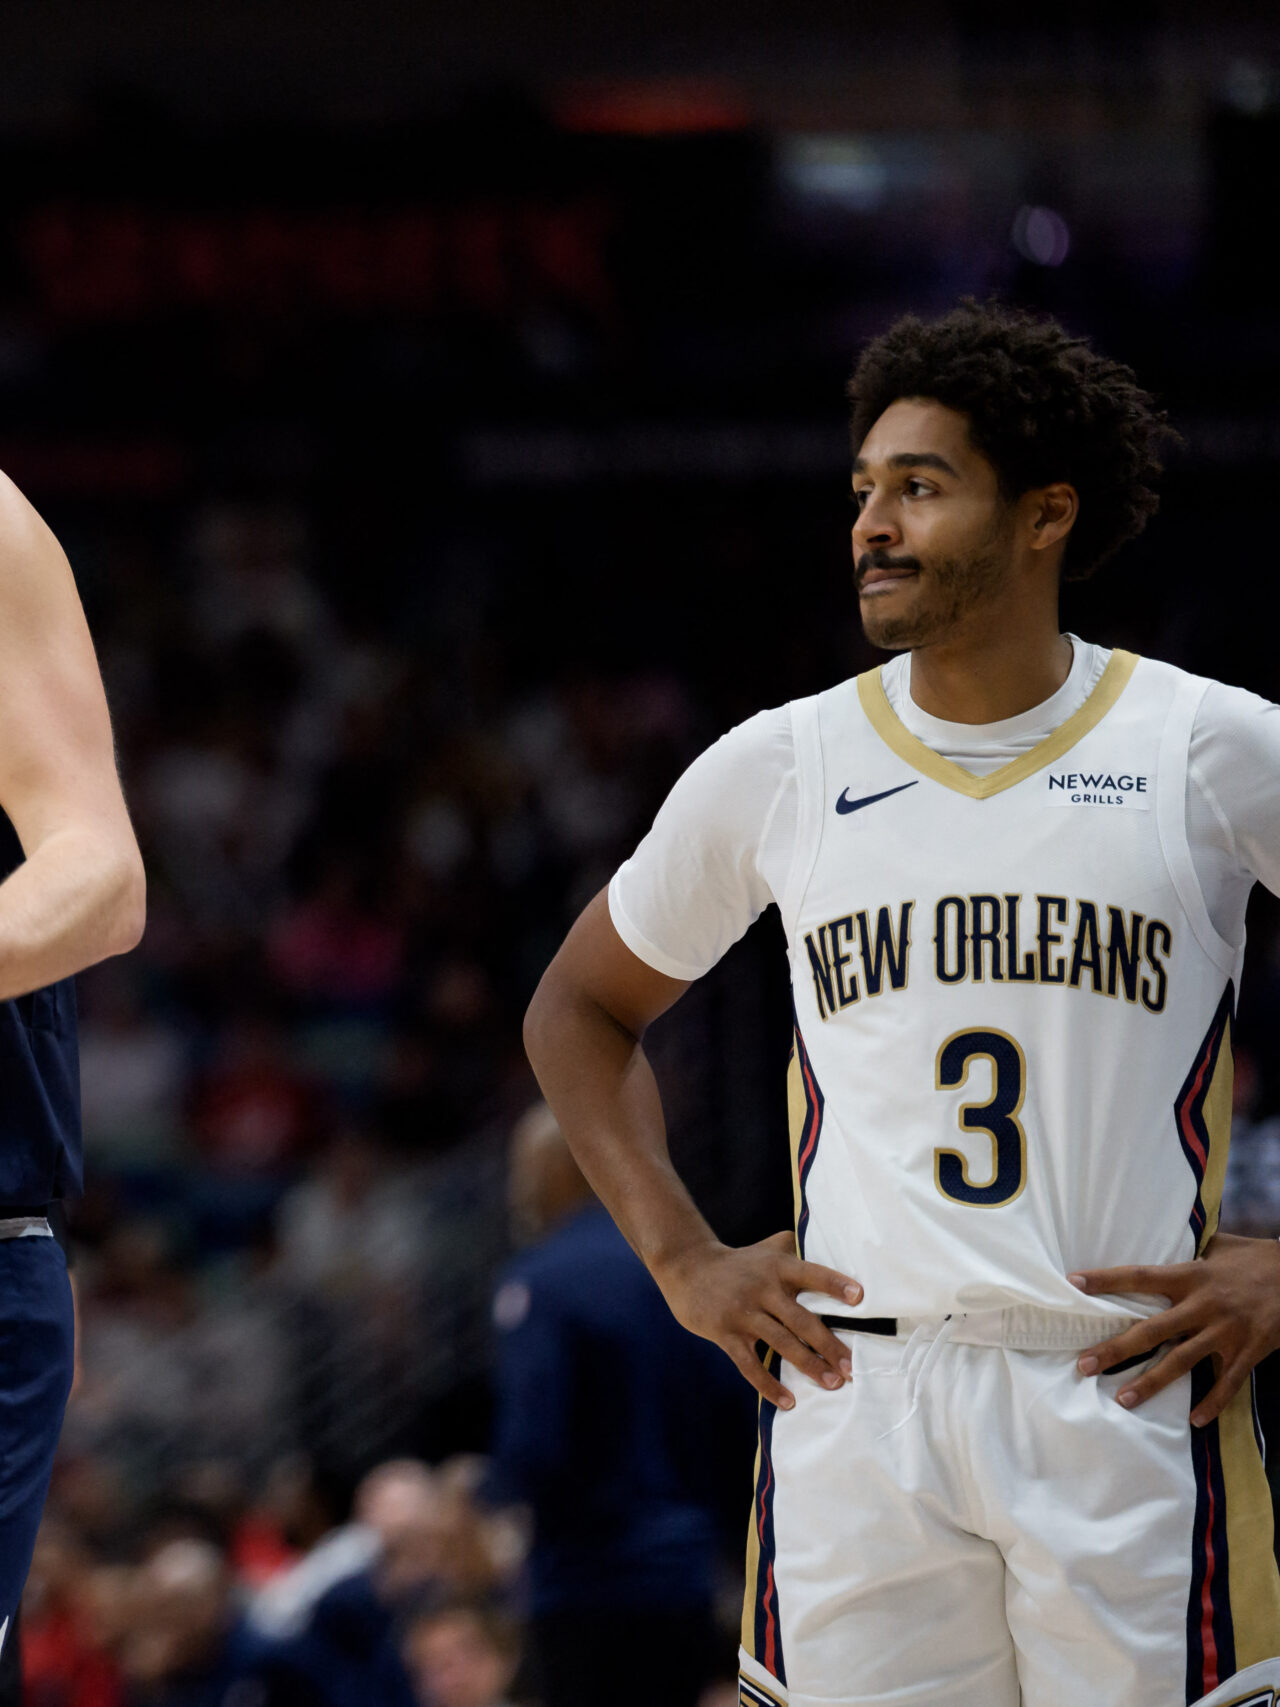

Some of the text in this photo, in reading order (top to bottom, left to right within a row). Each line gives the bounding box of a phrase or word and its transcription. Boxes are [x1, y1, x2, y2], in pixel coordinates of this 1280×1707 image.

[1049, 773, 1147, 793] NEWAGE
[1071, 794, 1124, 805] GRILLS
[804, 893, 1173, 1023] NEW ORLEANS
[934, 1026, 1027, 1209] 3
